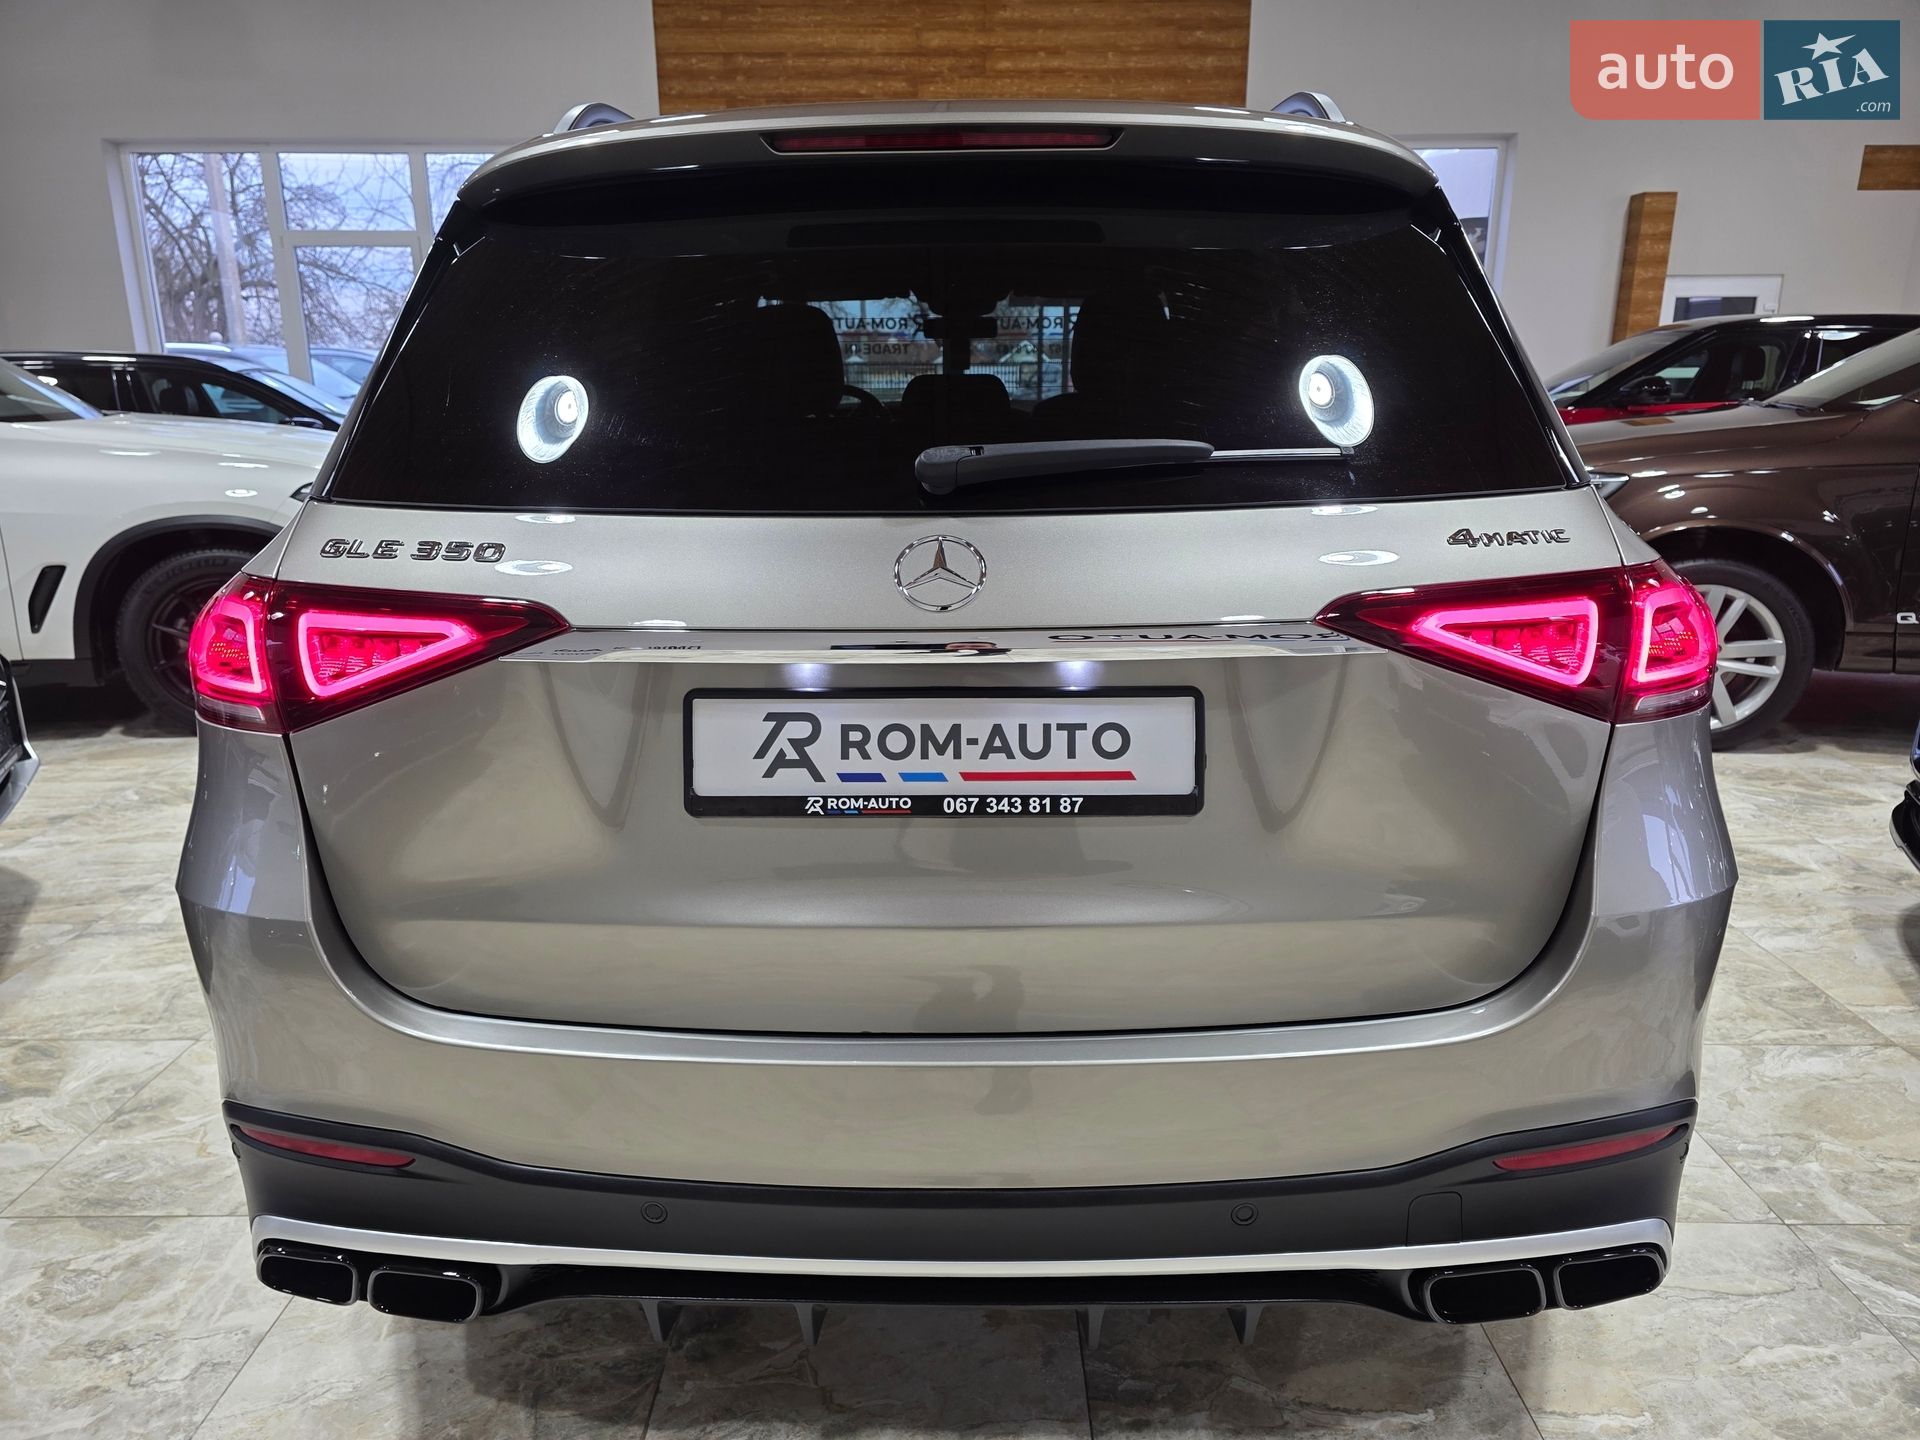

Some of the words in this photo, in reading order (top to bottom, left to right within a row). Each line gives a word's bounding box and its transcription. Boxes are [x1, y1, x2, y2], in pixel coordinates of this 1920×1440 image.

[320, 538, 405, 559] GLE
[409, 540, 507, 563] 350
[840, 721, 1131, 761] ROM-AUTO
[827, 797, 912, 810] ROM-AUTO
[942, 796, 979, 814] 067
[986, 796, 1023, 814] 343
[1028, 796, 1051, 814] 81
[1059, 796, 1084, 814] 87
